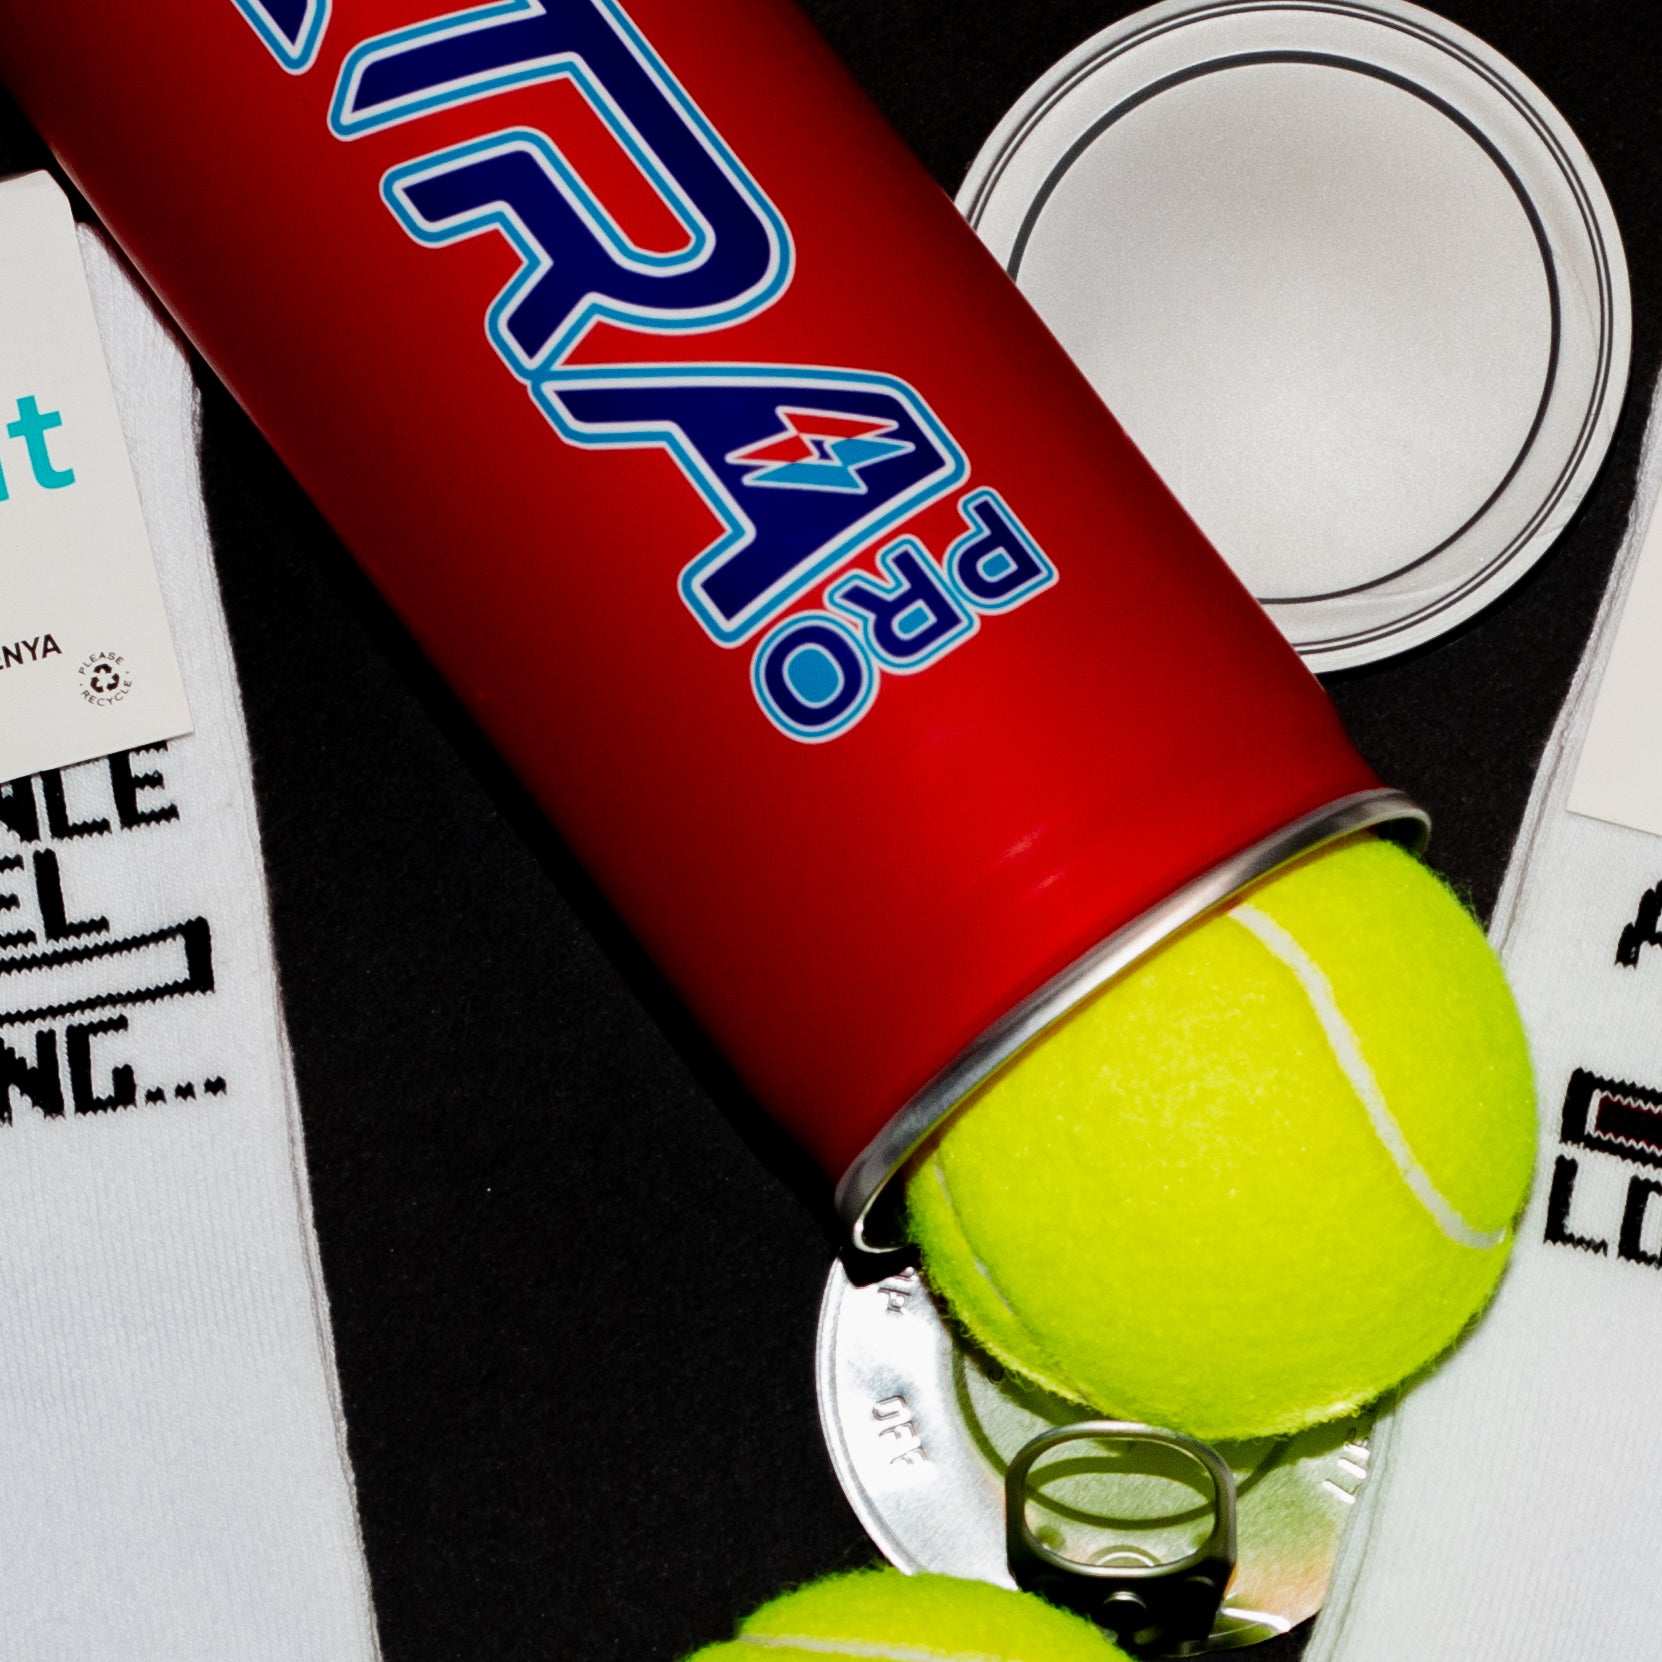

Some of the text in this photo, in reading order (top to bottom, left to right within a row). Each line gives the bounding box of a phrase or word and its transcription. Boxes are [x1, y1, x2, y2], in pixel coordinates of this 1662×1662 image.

[229, 0, 970, 648] TRA
[0, 395, 76, 502] t
[751, 486, 1060, 744] PRO
[0, 633, 62, 672] NYA
[79, 652, 124, 675] PLEASE
[81, 680, 132, 706] RECYCLE
